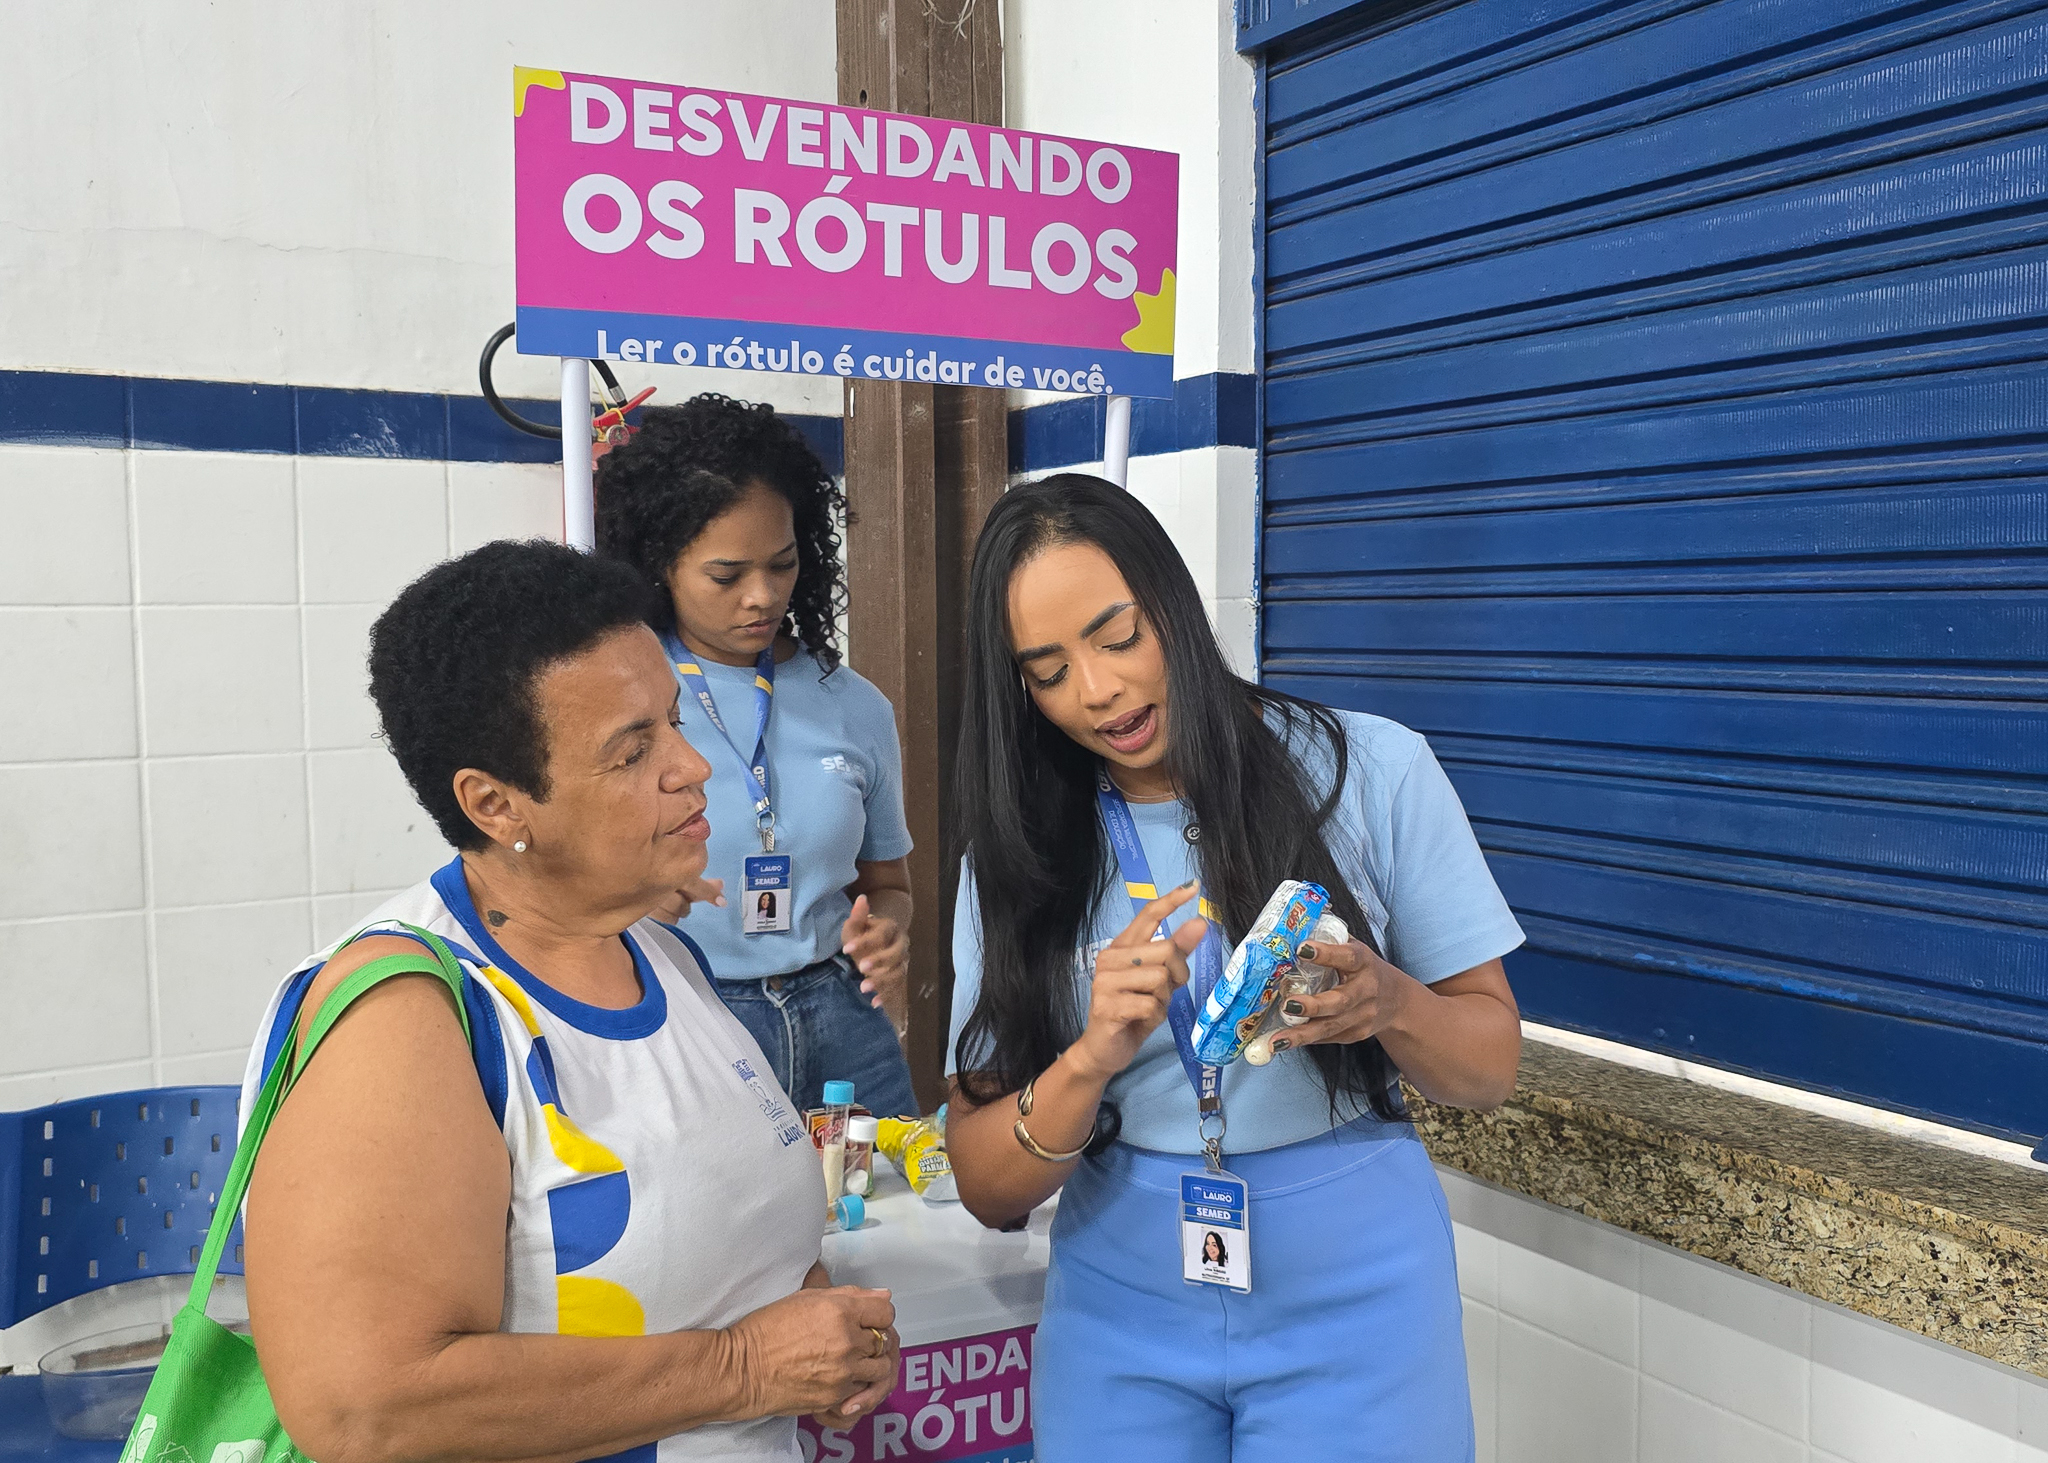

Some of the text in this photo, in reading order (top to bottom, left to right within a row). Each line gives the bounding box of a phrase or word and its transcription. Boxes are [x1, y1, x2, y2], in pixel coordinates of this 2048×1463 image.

[569, 81, 1132, 204] DESVENDANDO
[562, 173, 1138, 300] OS RÓTULOS
[597, 329, 1113, 394] Ler o rótulo é cuidar de você.
[778, 1123, 806, 1147] LAUR
[1196, 1206, 1231, 1221] SEMED
[1203, 1191, 1232, 1203] LAURO
[903, 1333, 1037, 1392] ENDA
[873, 1388, 1033, 1460] RÓTU
